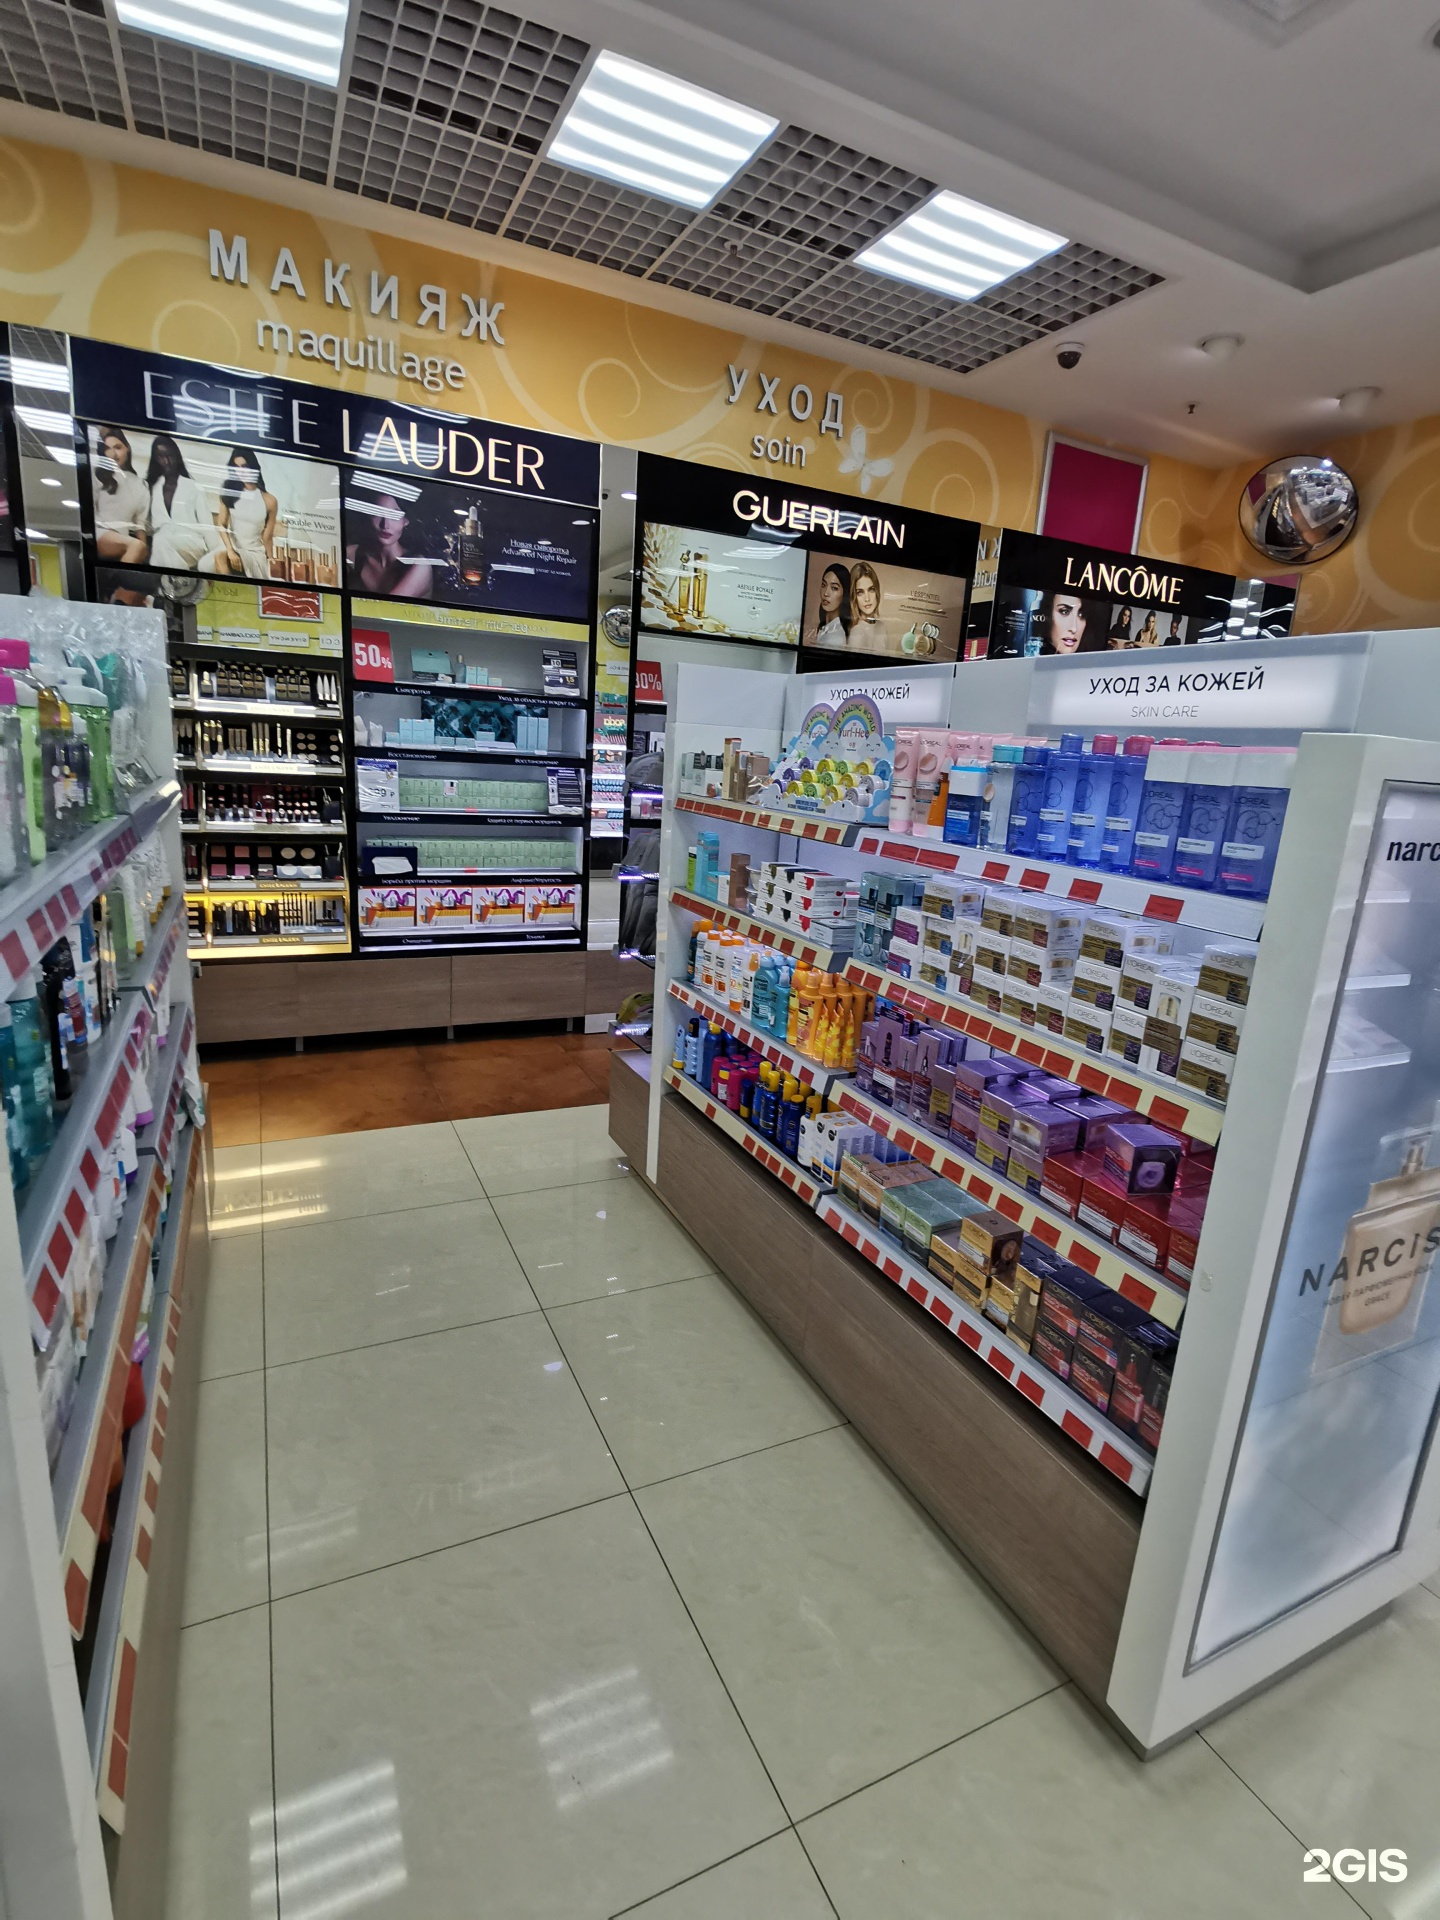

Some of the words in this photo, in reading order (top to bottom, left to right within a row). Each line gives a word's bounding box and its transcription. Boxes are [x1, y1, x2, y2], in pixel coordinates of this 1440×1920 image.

[208, 228, 505, 345] МАКИЯЖ
[256, 319, 467, 392] maquillage
[727, 364, 843, 438] УХОД
[342, 408, 545, 491] LAUDER
[752, 434, 806, 467] soin
[313, 520, 336, 532] Wear
[732, 489, 905, 549] GUERLAIN
[536, 552, 555, 563] Night
[1063, 557, 1185, 605] LANCÔME
[872, 683, 910, 700] КОЖЕЙ
[1089, 676, 1140, 696] УХОД
[1145, 675, 1171, 693] ЗА
[1177, 666, 1265, 692] КОЖЕЙ
[1131, 705, 1159, 718] SKIN
[1162, 705, 1200, 718] CARE
[1386, 841, 1440, 862] narc
[1298, 1226, 1440, 1297] NARCIS
